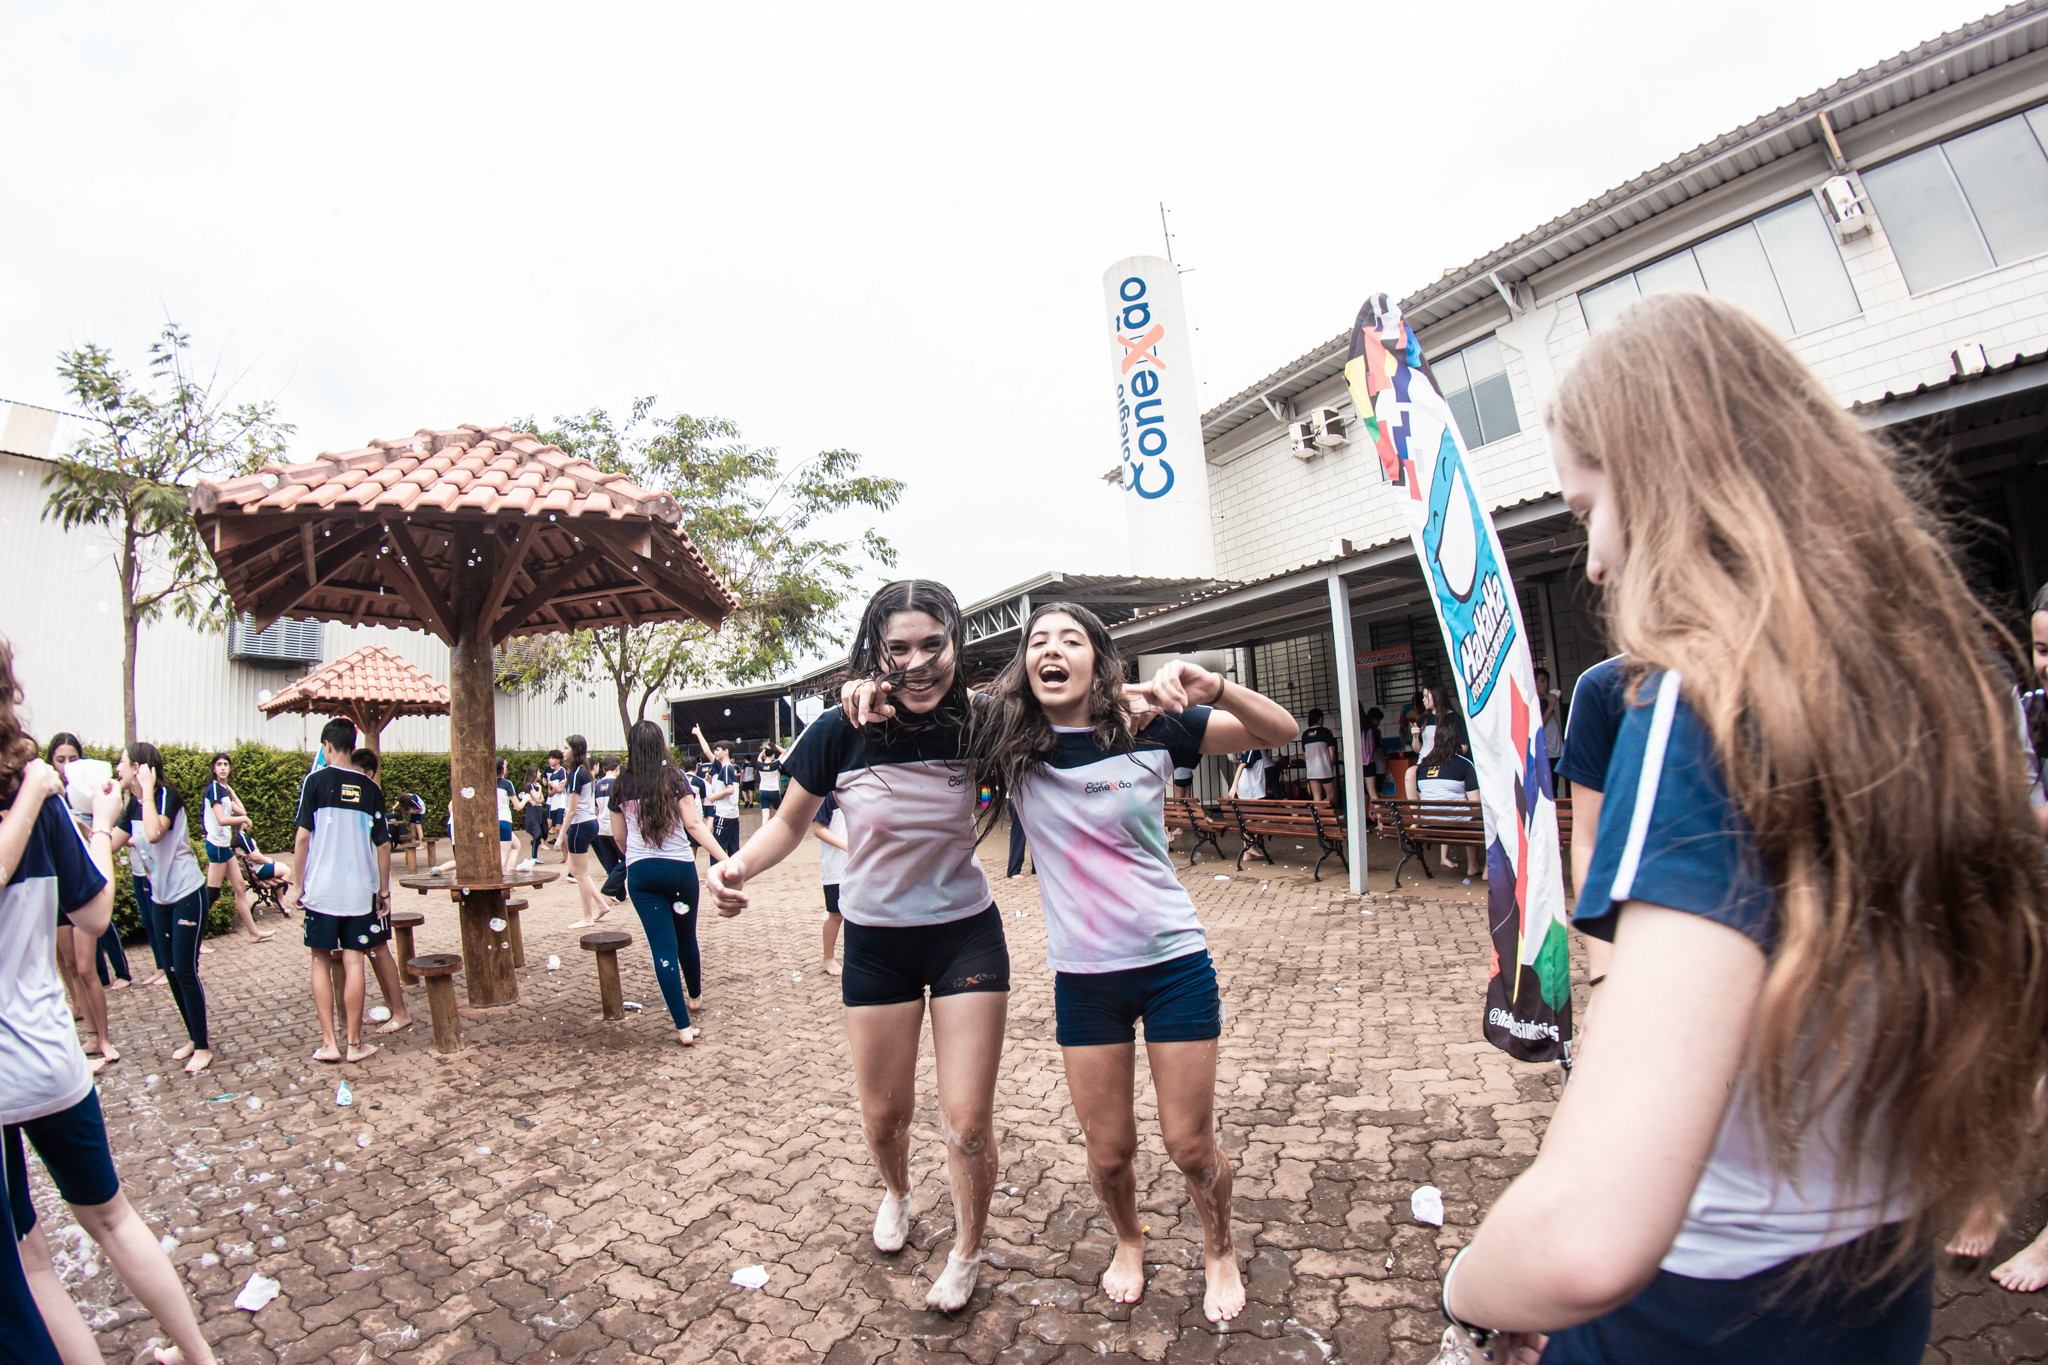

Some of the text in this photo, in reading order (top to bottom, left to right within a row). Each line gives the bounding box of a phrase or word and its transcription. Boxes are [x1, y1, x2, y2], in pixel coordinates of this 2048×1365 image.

[1356, 651, 1407, 666] ALGODÃO DOCE
[1460, 571, 1507, 687] HaHaHa
